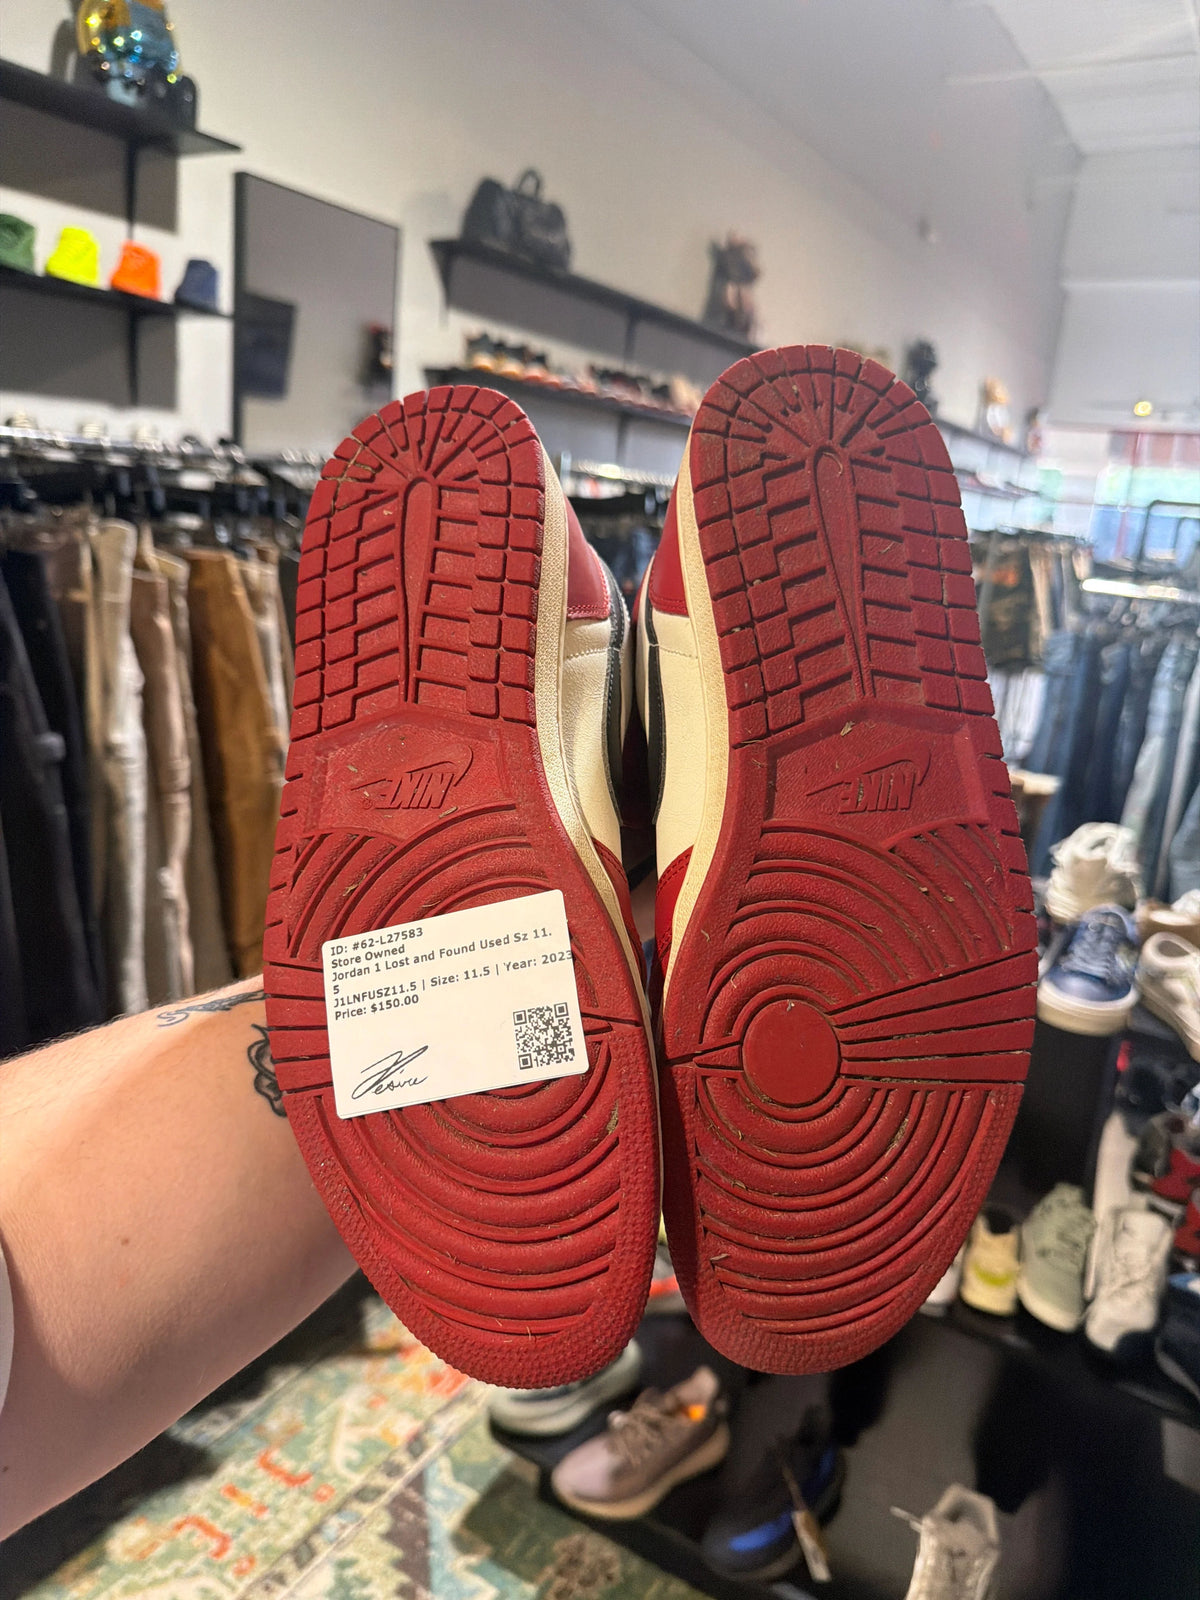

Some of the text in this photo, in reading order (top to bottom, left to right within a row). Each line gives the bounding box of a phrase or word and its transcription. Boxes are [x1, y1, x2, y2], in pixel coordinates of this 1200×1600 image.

[375, 772, 455, 810] NIKE
[838, 773, 916, 814] NIKE
[330, 927, 424, 956] ID: #62-L27583
[331, 927, 552, 982] Jordan 1 Lost and Found Used Sz 11.
[331, 944, 406, 969] Store Owned
[333, 981, 417, 1008] J1LNFUSZ11.5
[430, 974, 459, 987] Size:
[463, 966, 491, 980] 11.5
[503, 958, 537, 972] Year:
[541, 950, 573, 965] 2023
[333, 985, 340, 995] 5
[335, 994, 419, 1021] Price: $150.00
